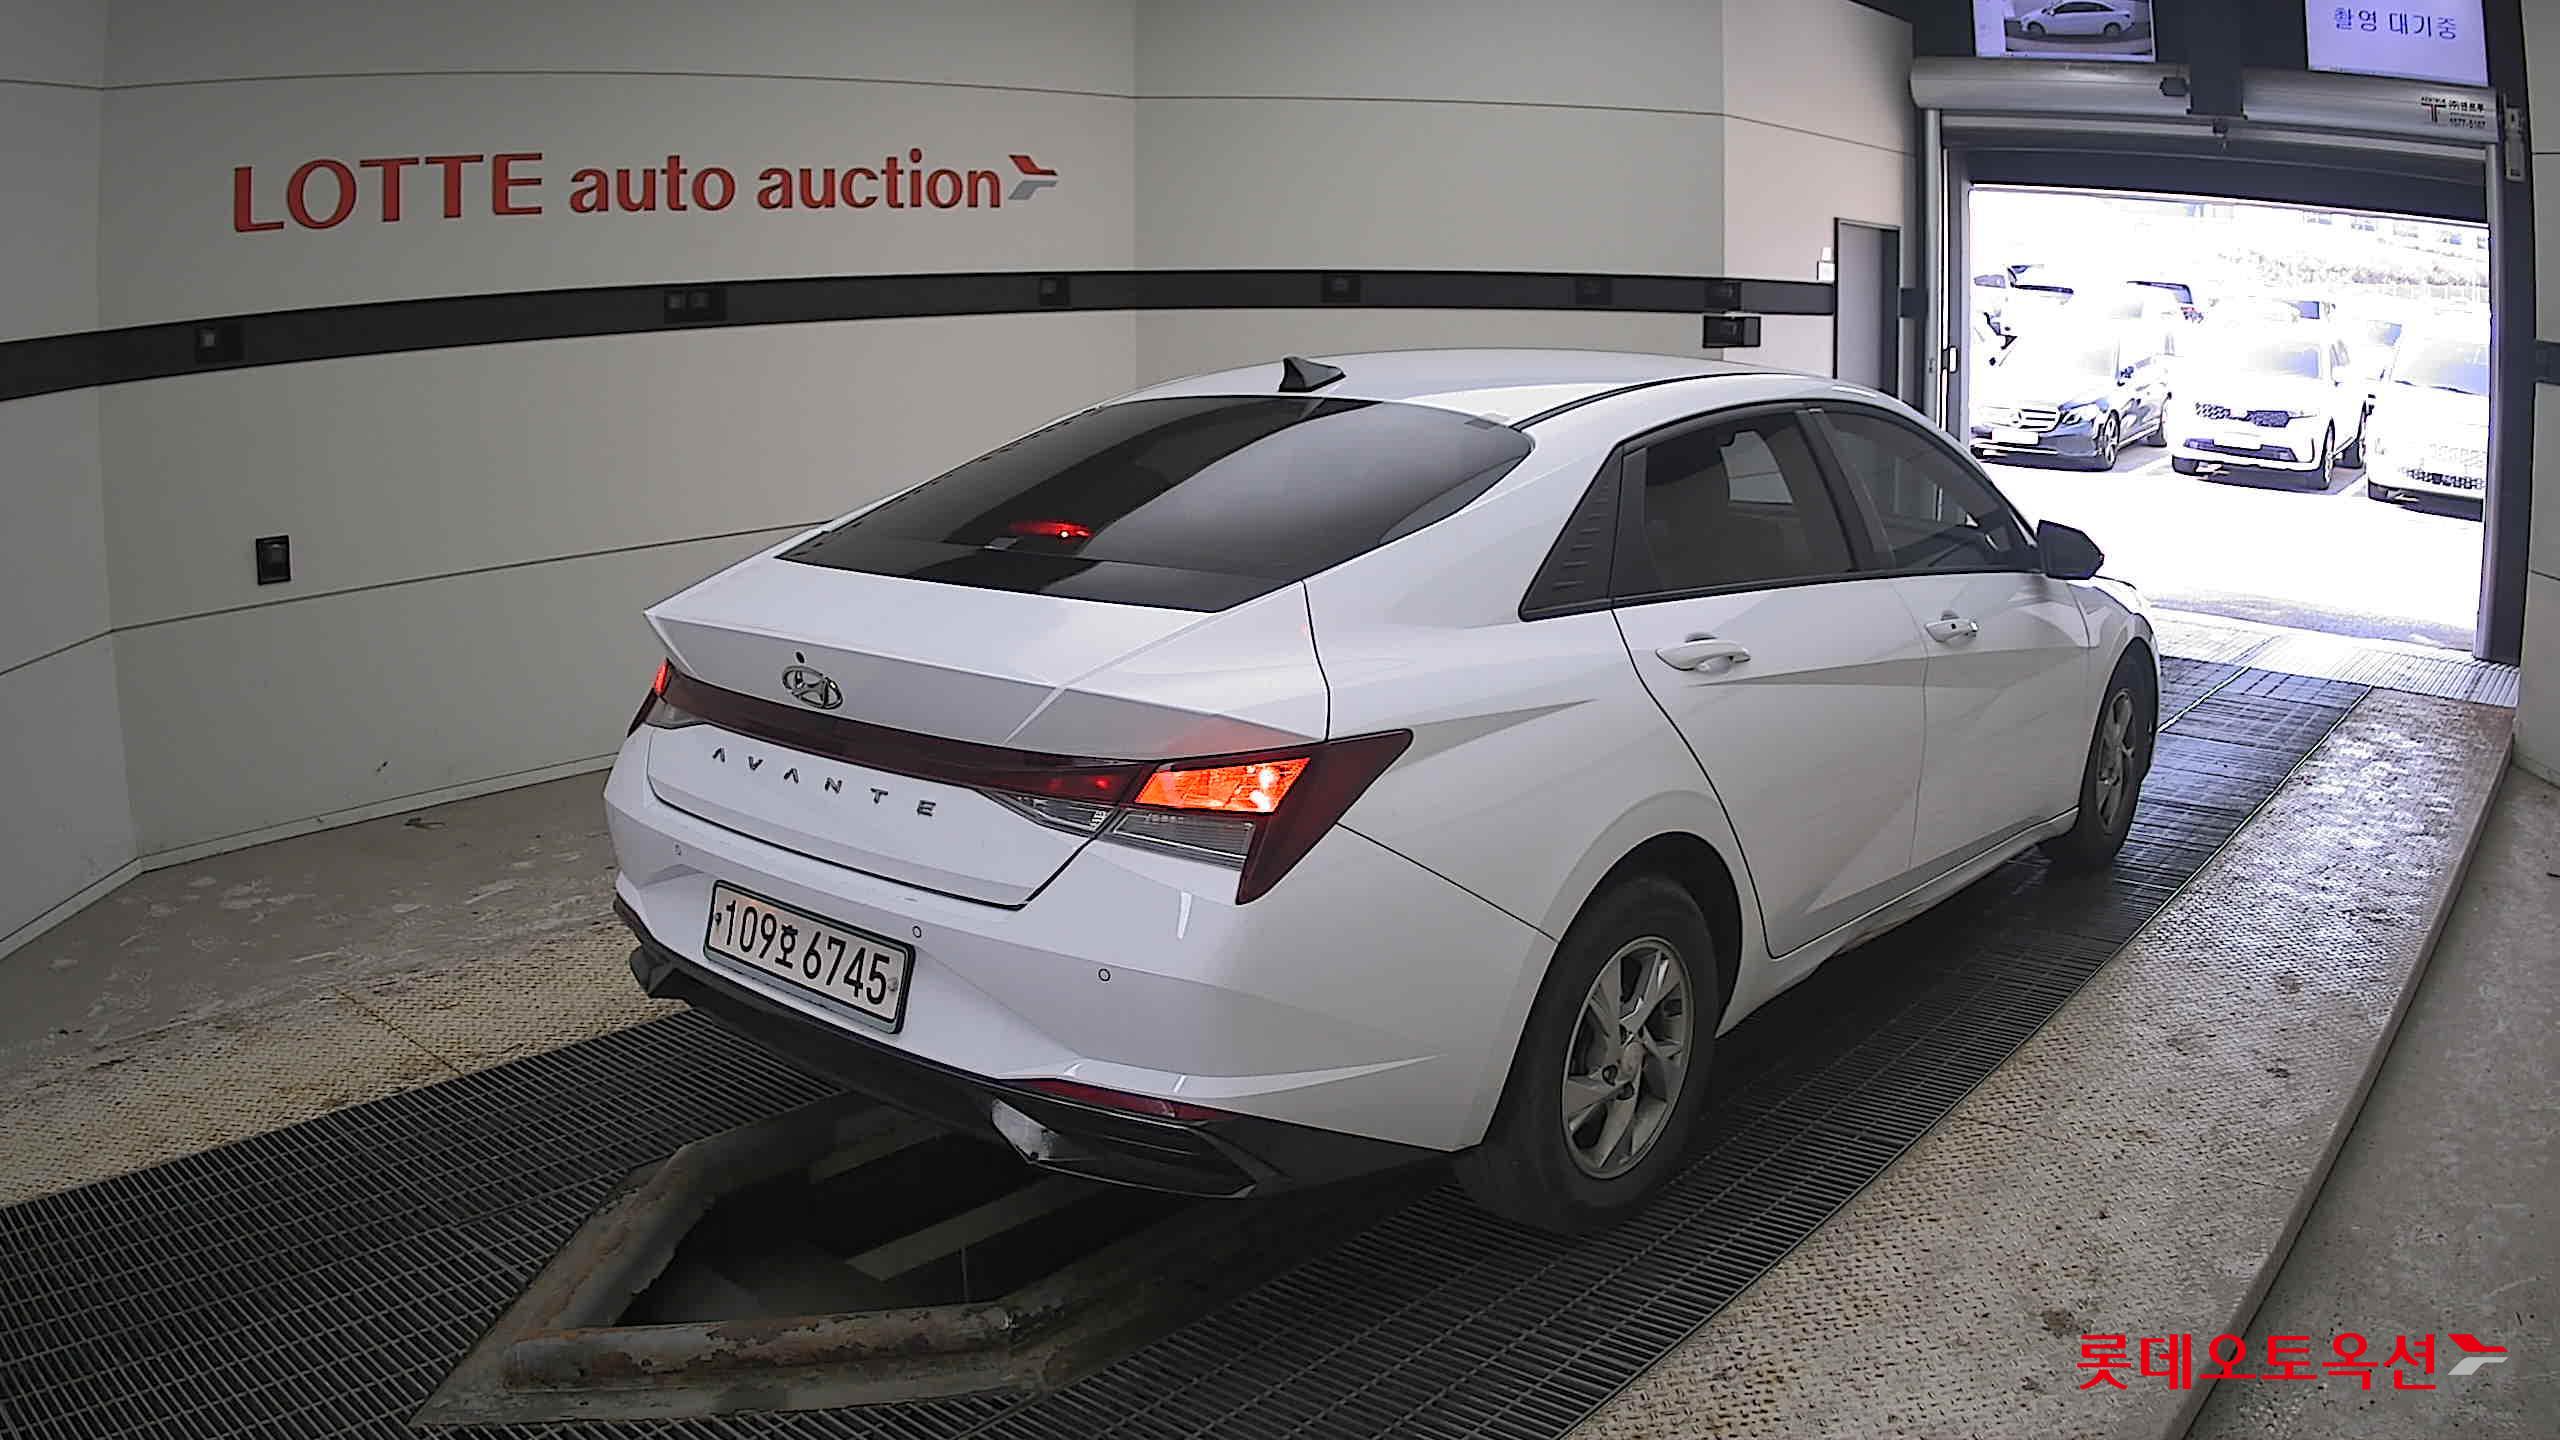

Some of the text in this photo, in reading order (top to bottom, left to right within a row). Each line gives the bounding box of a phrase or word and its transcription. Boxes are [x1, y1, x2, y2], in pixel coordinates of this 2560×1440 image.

[2388, 12, 2457, 40] 대기중
[234, 147, 1001, 233] LOTTE auto auction
[712, 747, 937, 817] AVANTE
